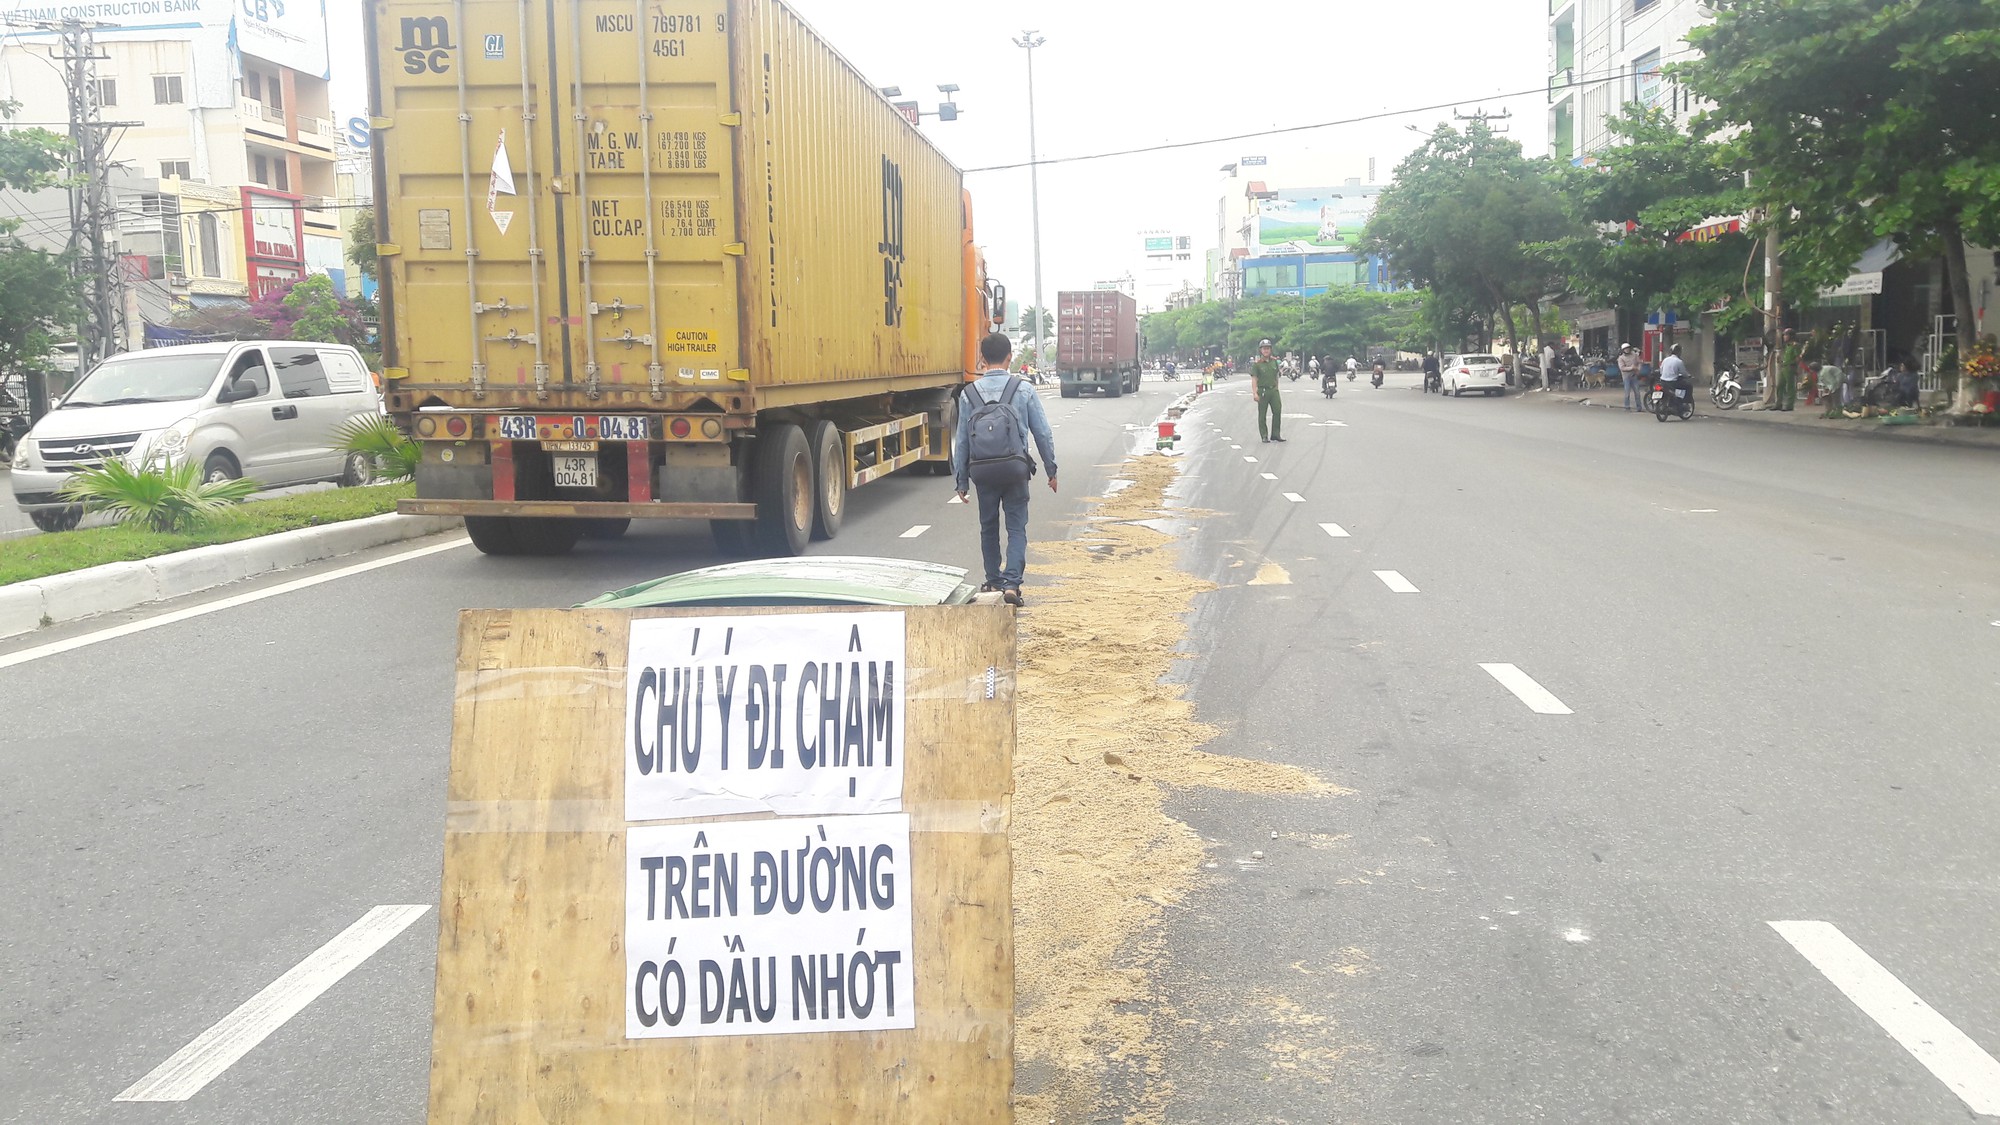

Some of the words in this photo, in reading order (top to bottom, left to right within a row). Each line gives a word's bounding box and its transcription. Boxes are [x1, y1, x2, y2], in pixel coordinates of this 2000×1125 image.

[2, 8, 58, 21] VIETNAM
[61, 1, 160, 19] CONSTRUCTION
[164, 0, 201, 13] BANK
[595, 14, 633, 32] MSCU
[652, 15, 701, 33] 769781
[717, 14, 725, 32] 9
[485, 35, 503, 52] GL
[653, 39, 685, 57] 45G1
[693, 132, 706, 141] KGS
[693, 141, 706, 150] LBS
[589, 151, 625, 169] TARE
[693, 151, 707, 160] KGS
[694, 160, 707, 169] LBS
[591, 200, 619, 217] NET
[696, 201, 710, 209] KGS
[696, 210, 709, 218] LBS
[592, 219, 645, 237] CU.CAP.
[676, 331, 708, 341] CAUTION
[667, 343, 685, 352] HIGH
[686, 343, 717, 352] TRAILER
[502, 416, 537, 438] 43R
[600, 416, 648, 439] 04.81
[564, 458, 586, 471] 43R
[556, 472, 595, 485] 004.81
[633, 627, 703, 775] CHÚ
[715, 627, 738, 771] Ý
[745, 663, 787, 770] ĐI
[796, 623, 894, 798] CHẬM
[640, 830, 739, 921] TRÊN
[750, 824, 895, 916] ĐƯỜNG
[634, 936, 687, 1027] CÓ
[699, 934, 777, 1024] DẦU
[791, 927, 901, 1020] NHỚT
